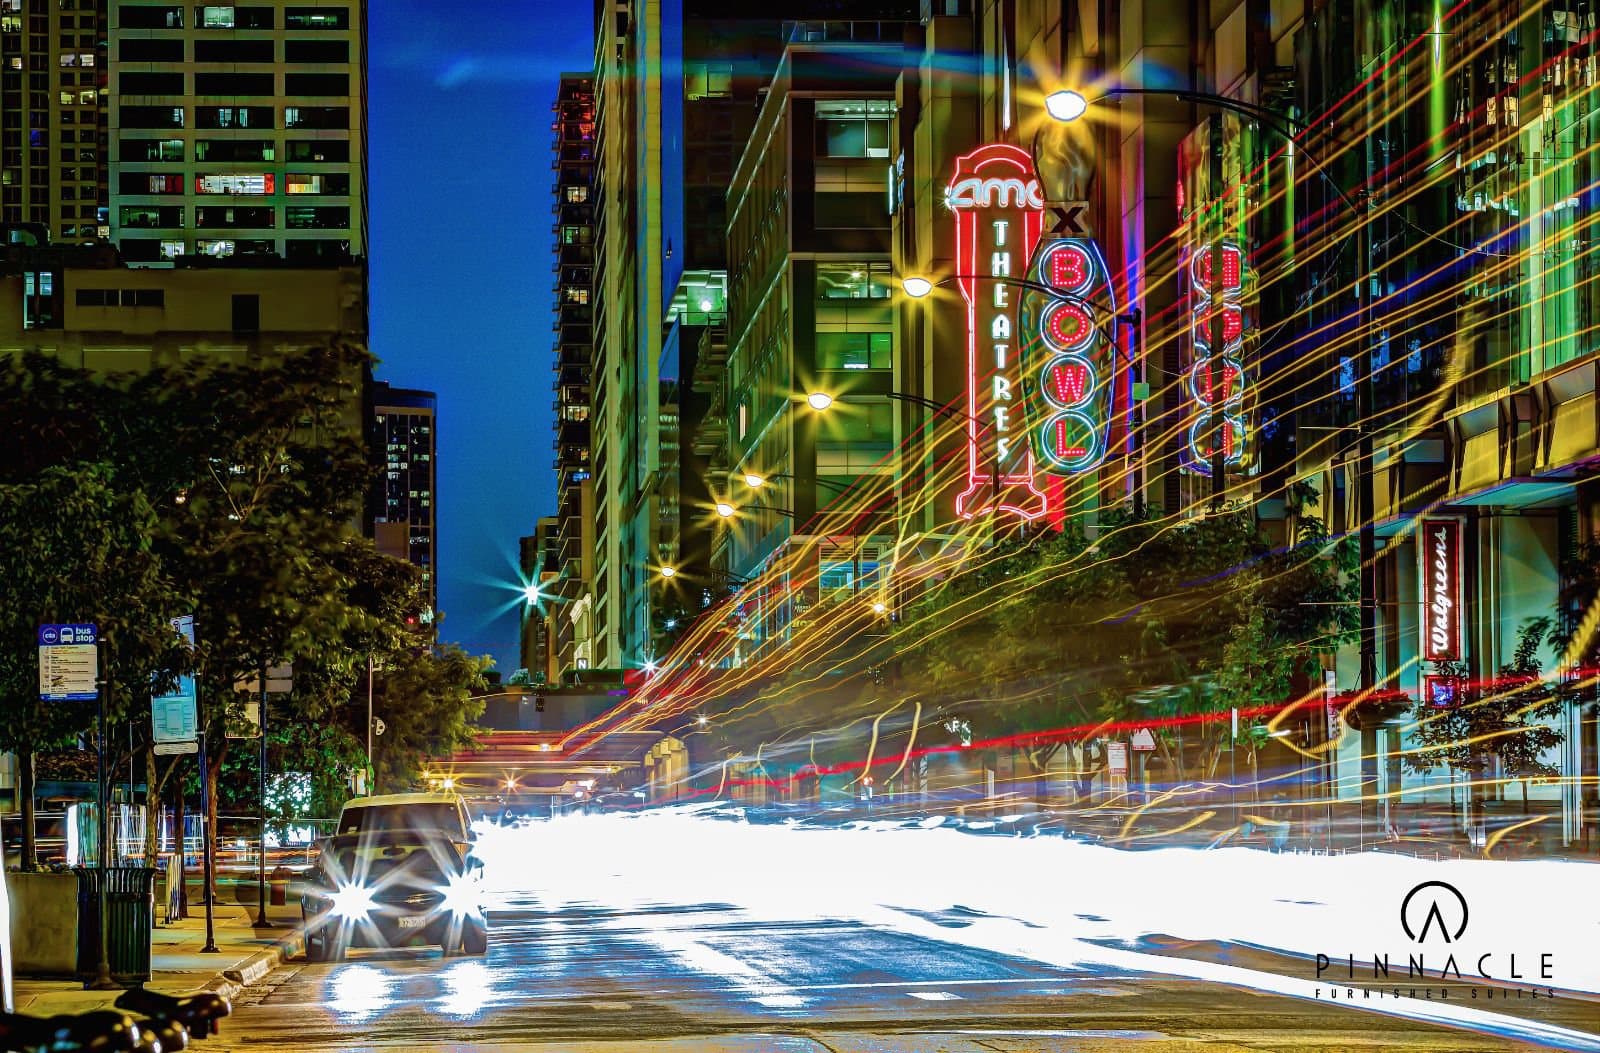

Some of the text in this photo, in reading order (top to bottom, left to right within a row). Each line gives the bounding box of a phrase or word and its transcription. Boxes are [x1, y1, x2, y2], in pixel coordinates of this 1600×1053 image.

[949, 178, 1043, 208] amc
[992, 220, 1012, 464] THEATRES
[1050, 249, 1089, 458] BOWL
[1432, 526, 1453, 654] Walgreens
[76, 627, 91, 635] bus
[76, 634, 95, 644] stop
